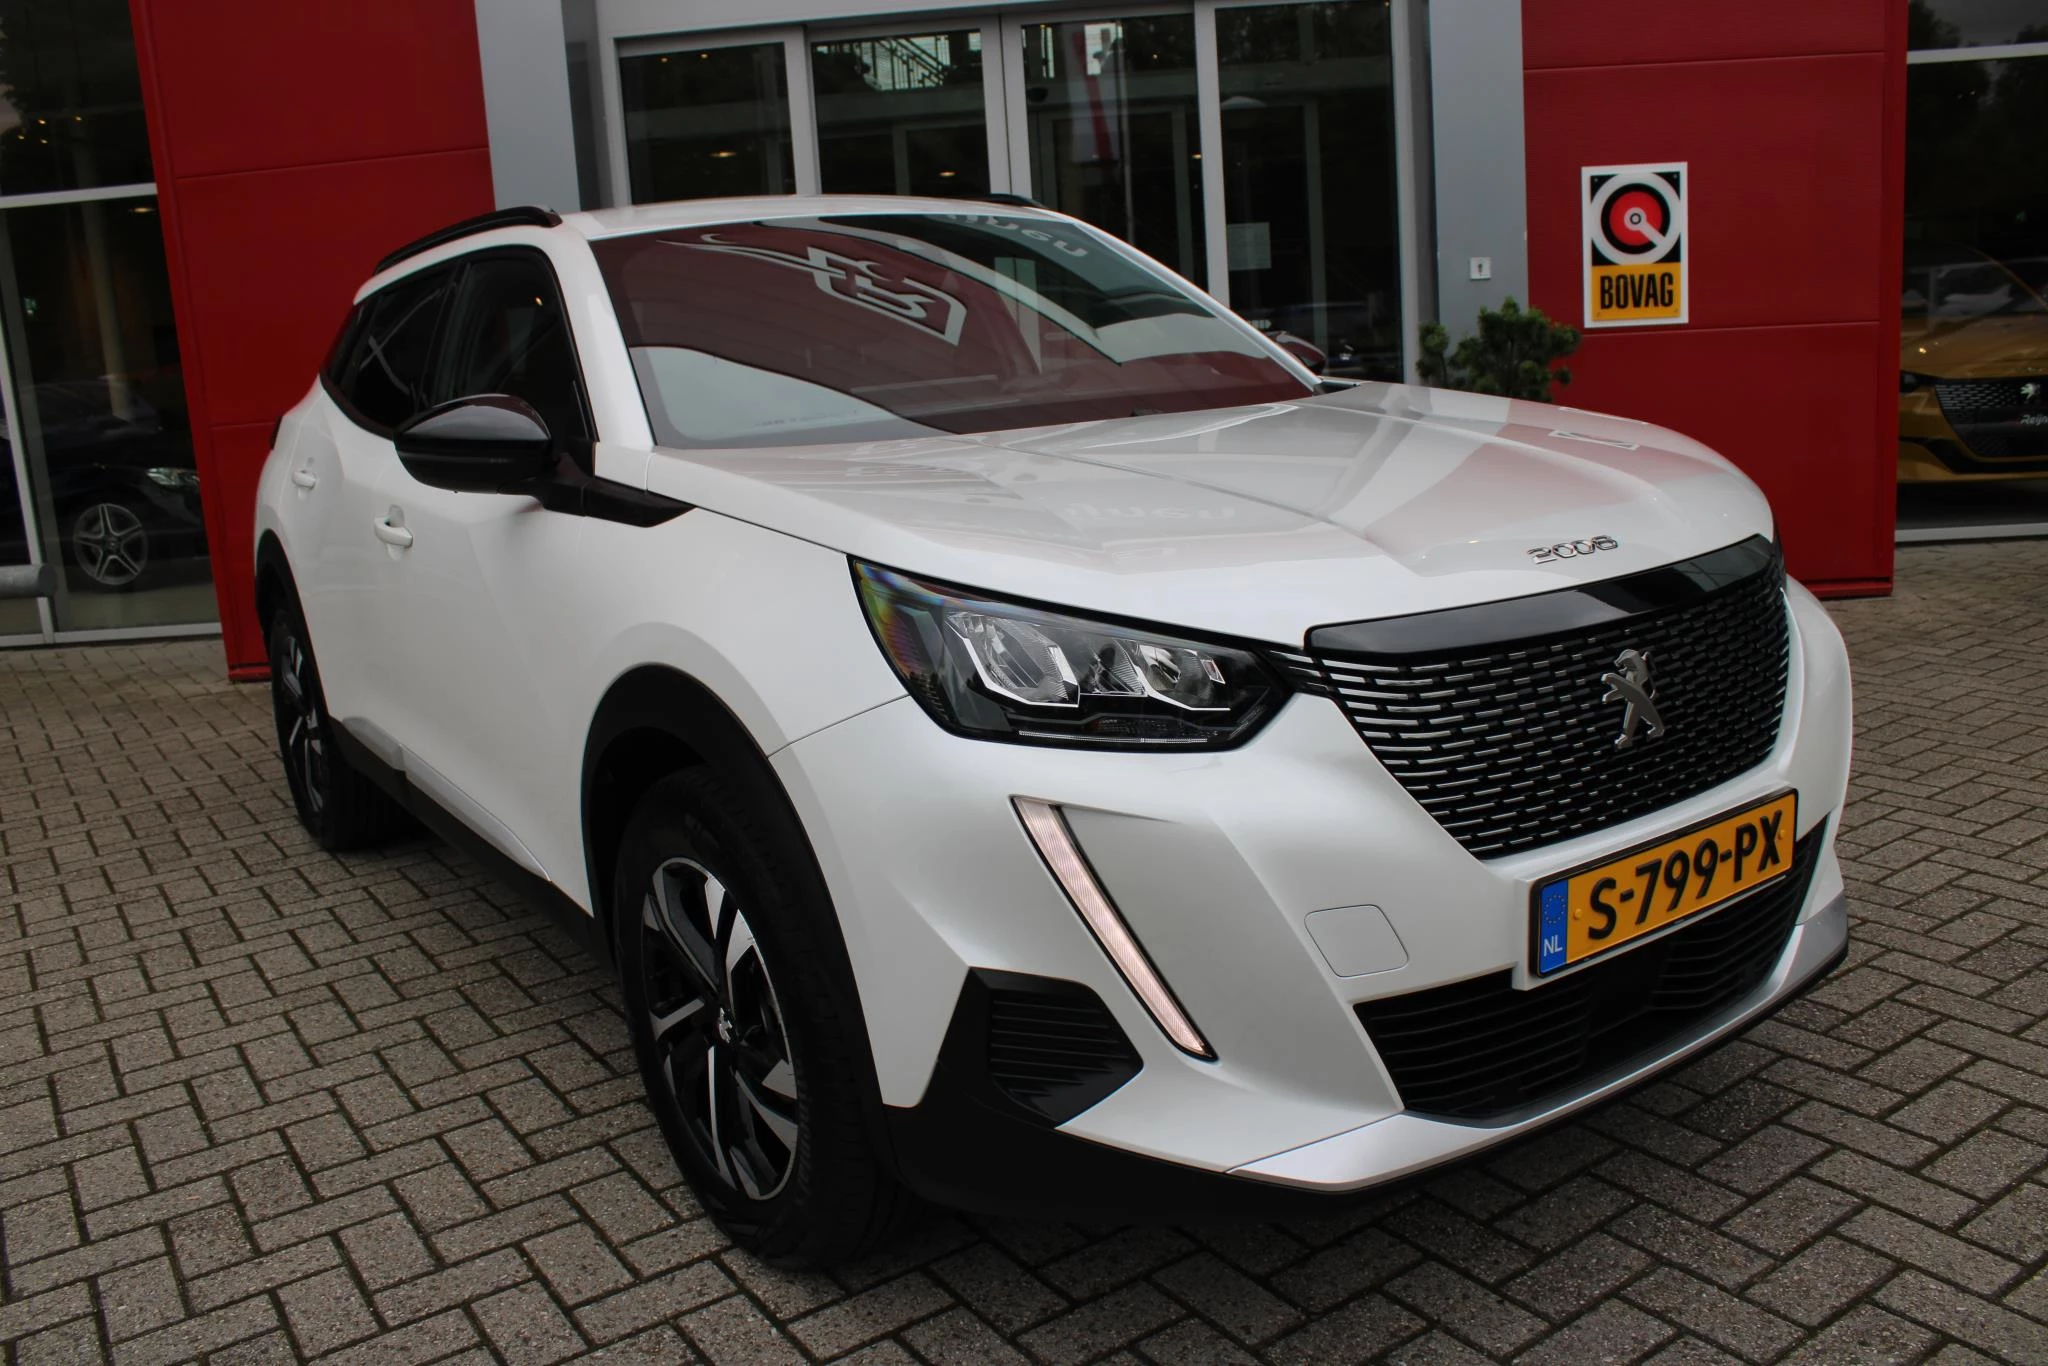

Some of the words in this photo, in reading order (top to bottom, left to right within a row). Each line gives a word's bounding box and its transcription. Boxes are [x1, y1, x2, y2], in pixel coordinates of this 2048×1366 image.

[1601, 273, 1673, 308] BOVAG
[1528, 535, 1618, 564] 2008
[1589, 811, 1782, 940] S-799-PX
[1544, 936, 1562, 956] NL
